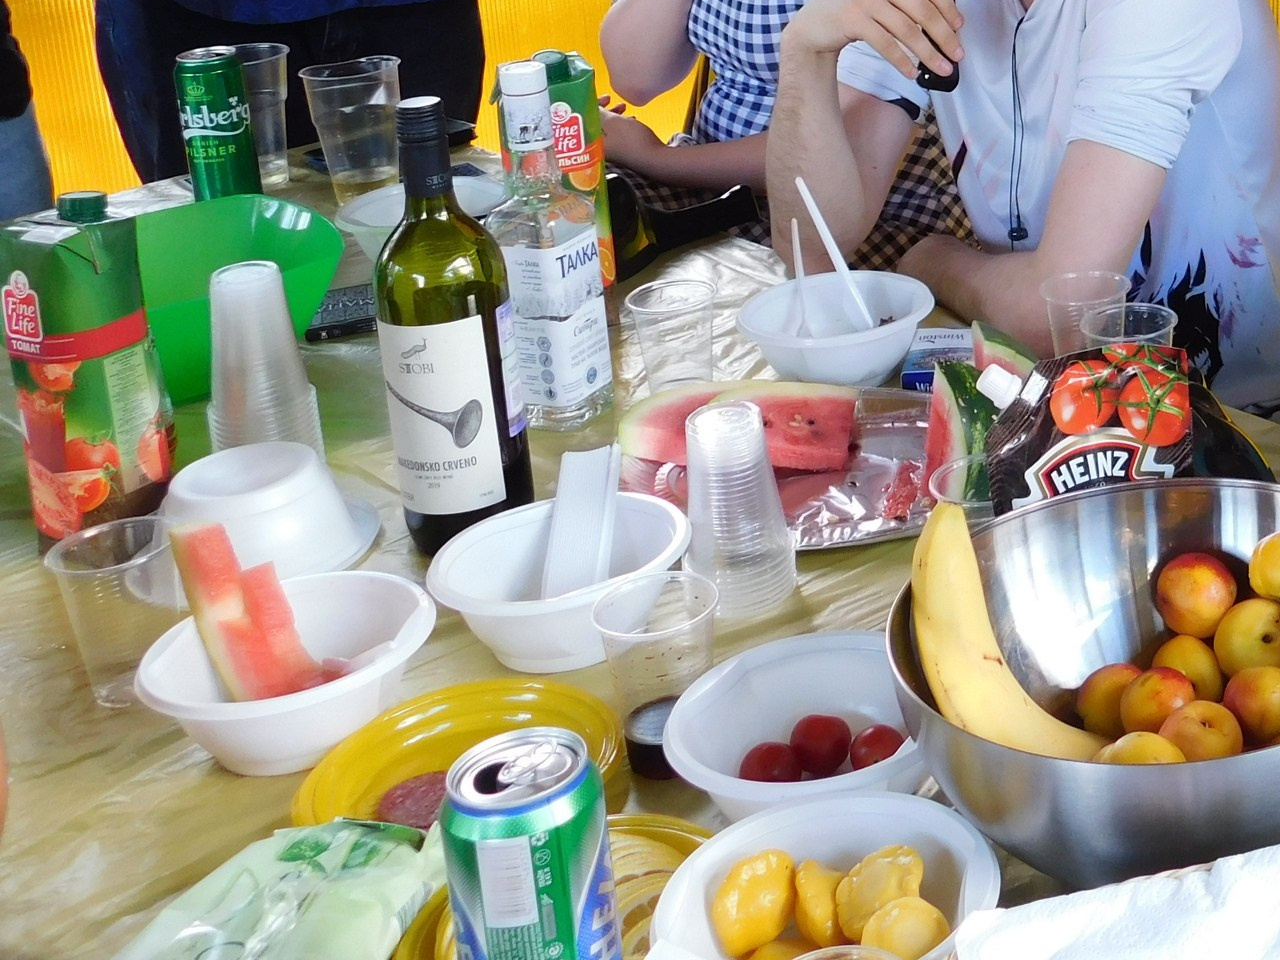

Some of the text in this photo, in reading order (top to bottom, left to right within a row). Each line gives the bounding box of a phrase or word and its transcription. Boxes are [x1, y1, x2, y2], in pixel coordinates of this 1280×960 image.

[179, 102, 251, 128] rlsberg
[552, 124, 578, 138] ine
[558, 153, 590, 167] ЛЬСИН
[555, 241, 599, 278] ТАЛКА
[7, 297, 36, 316] Fine
[11, 312, 36, 334] Life
[919, 333, 965, 343] Winston
[399, 362, 434, 375] STOBI
[443, 455, 477, 472] CRVENO
[1050, 451, 1130, 494] HEINZ
